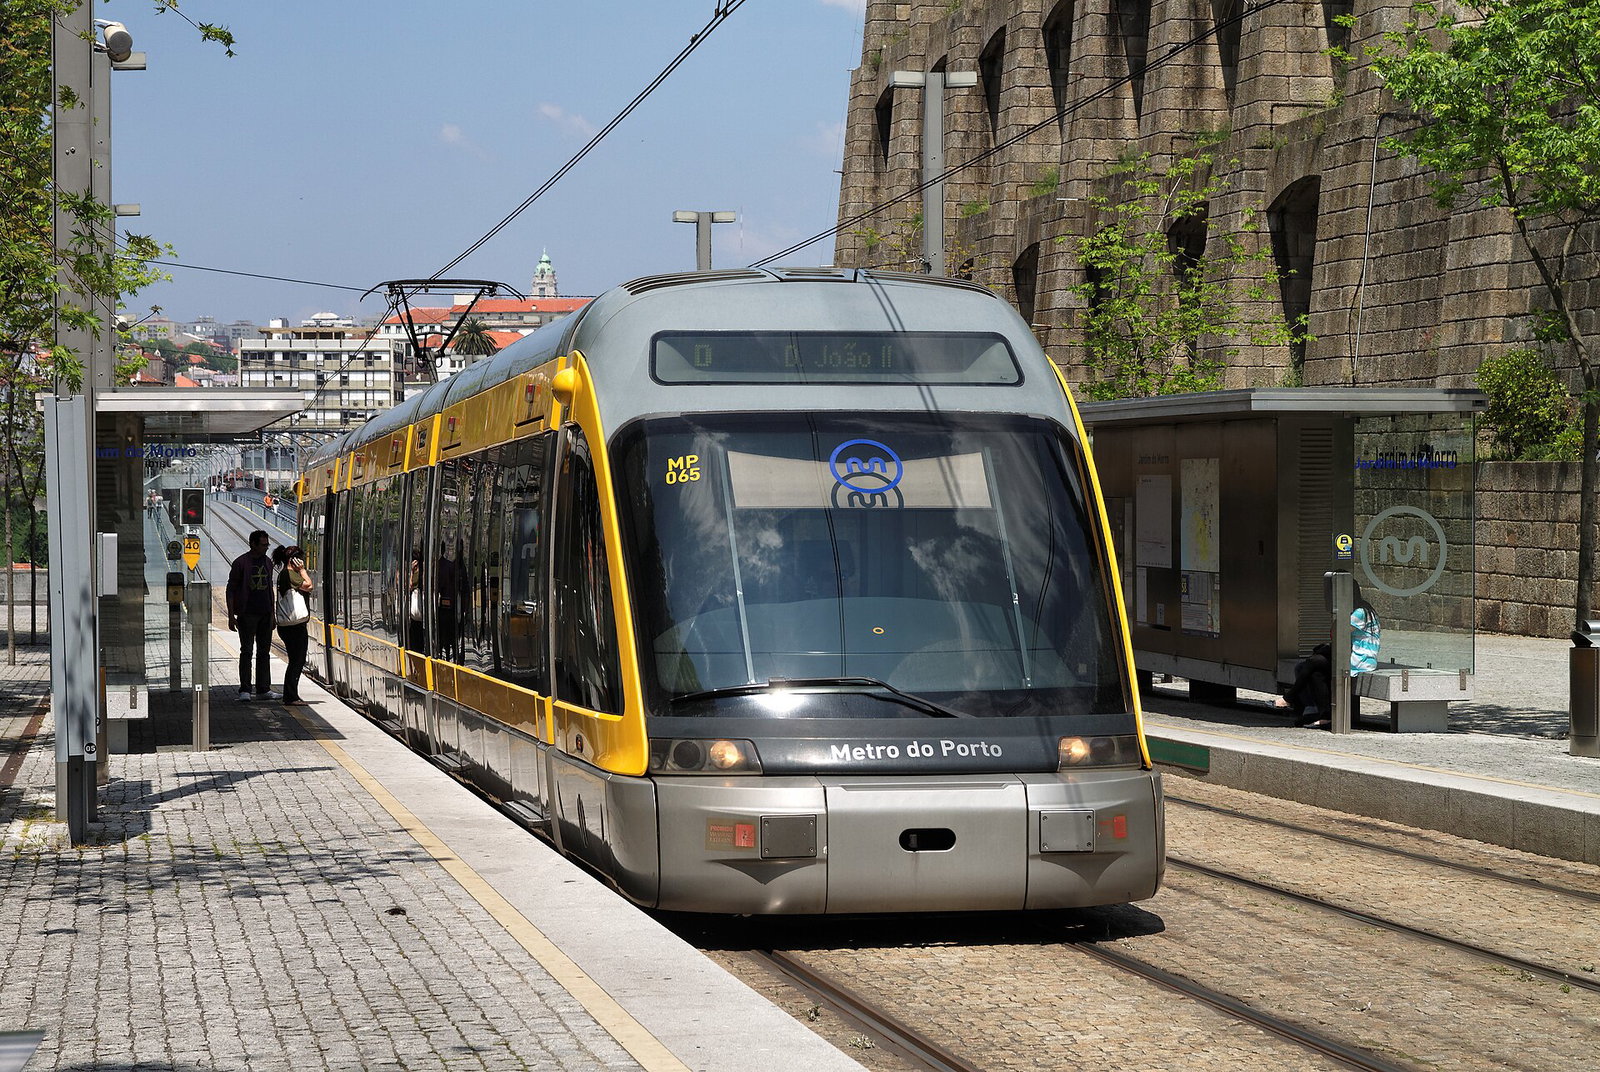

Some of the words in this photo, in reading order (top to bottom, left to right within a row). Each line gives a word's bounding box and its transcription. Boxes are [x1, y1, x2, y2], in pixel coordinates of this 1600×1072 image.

[694, 344, 712, 367] D
[815, 342, 871, 367] João
[150, 444, 197, 458] Morro
[667, 454, 699, 471] MP
[665, 467, 700, 485] 065
[185, 541, 200, 550] 40
[830, 743, 900, 762] Metro
[906, 740, 935, 758] do
[939, 739, 1003, 758] Porto
